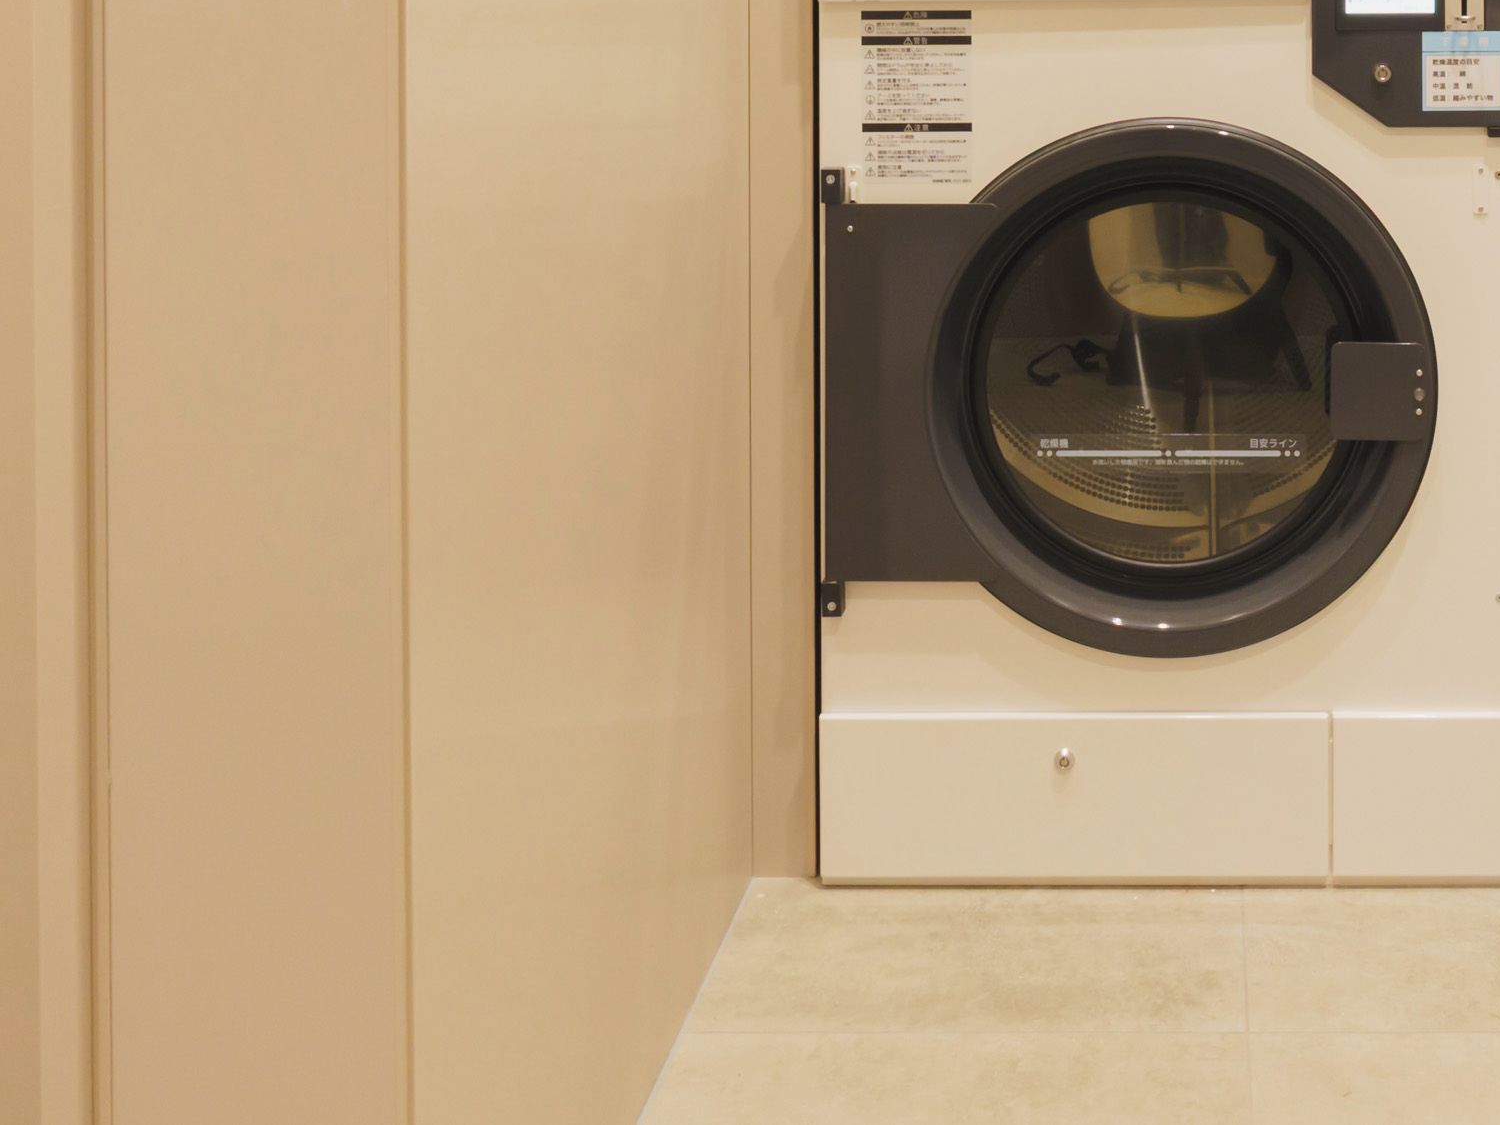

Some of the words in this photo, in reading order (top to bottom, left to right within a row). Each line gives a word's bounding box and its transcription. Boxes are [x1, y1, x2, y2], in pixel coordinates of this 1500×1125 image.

[1040, 438, 1068, 448] 乾燥機
[1250, 438, 1297, 448] 目安ライン
